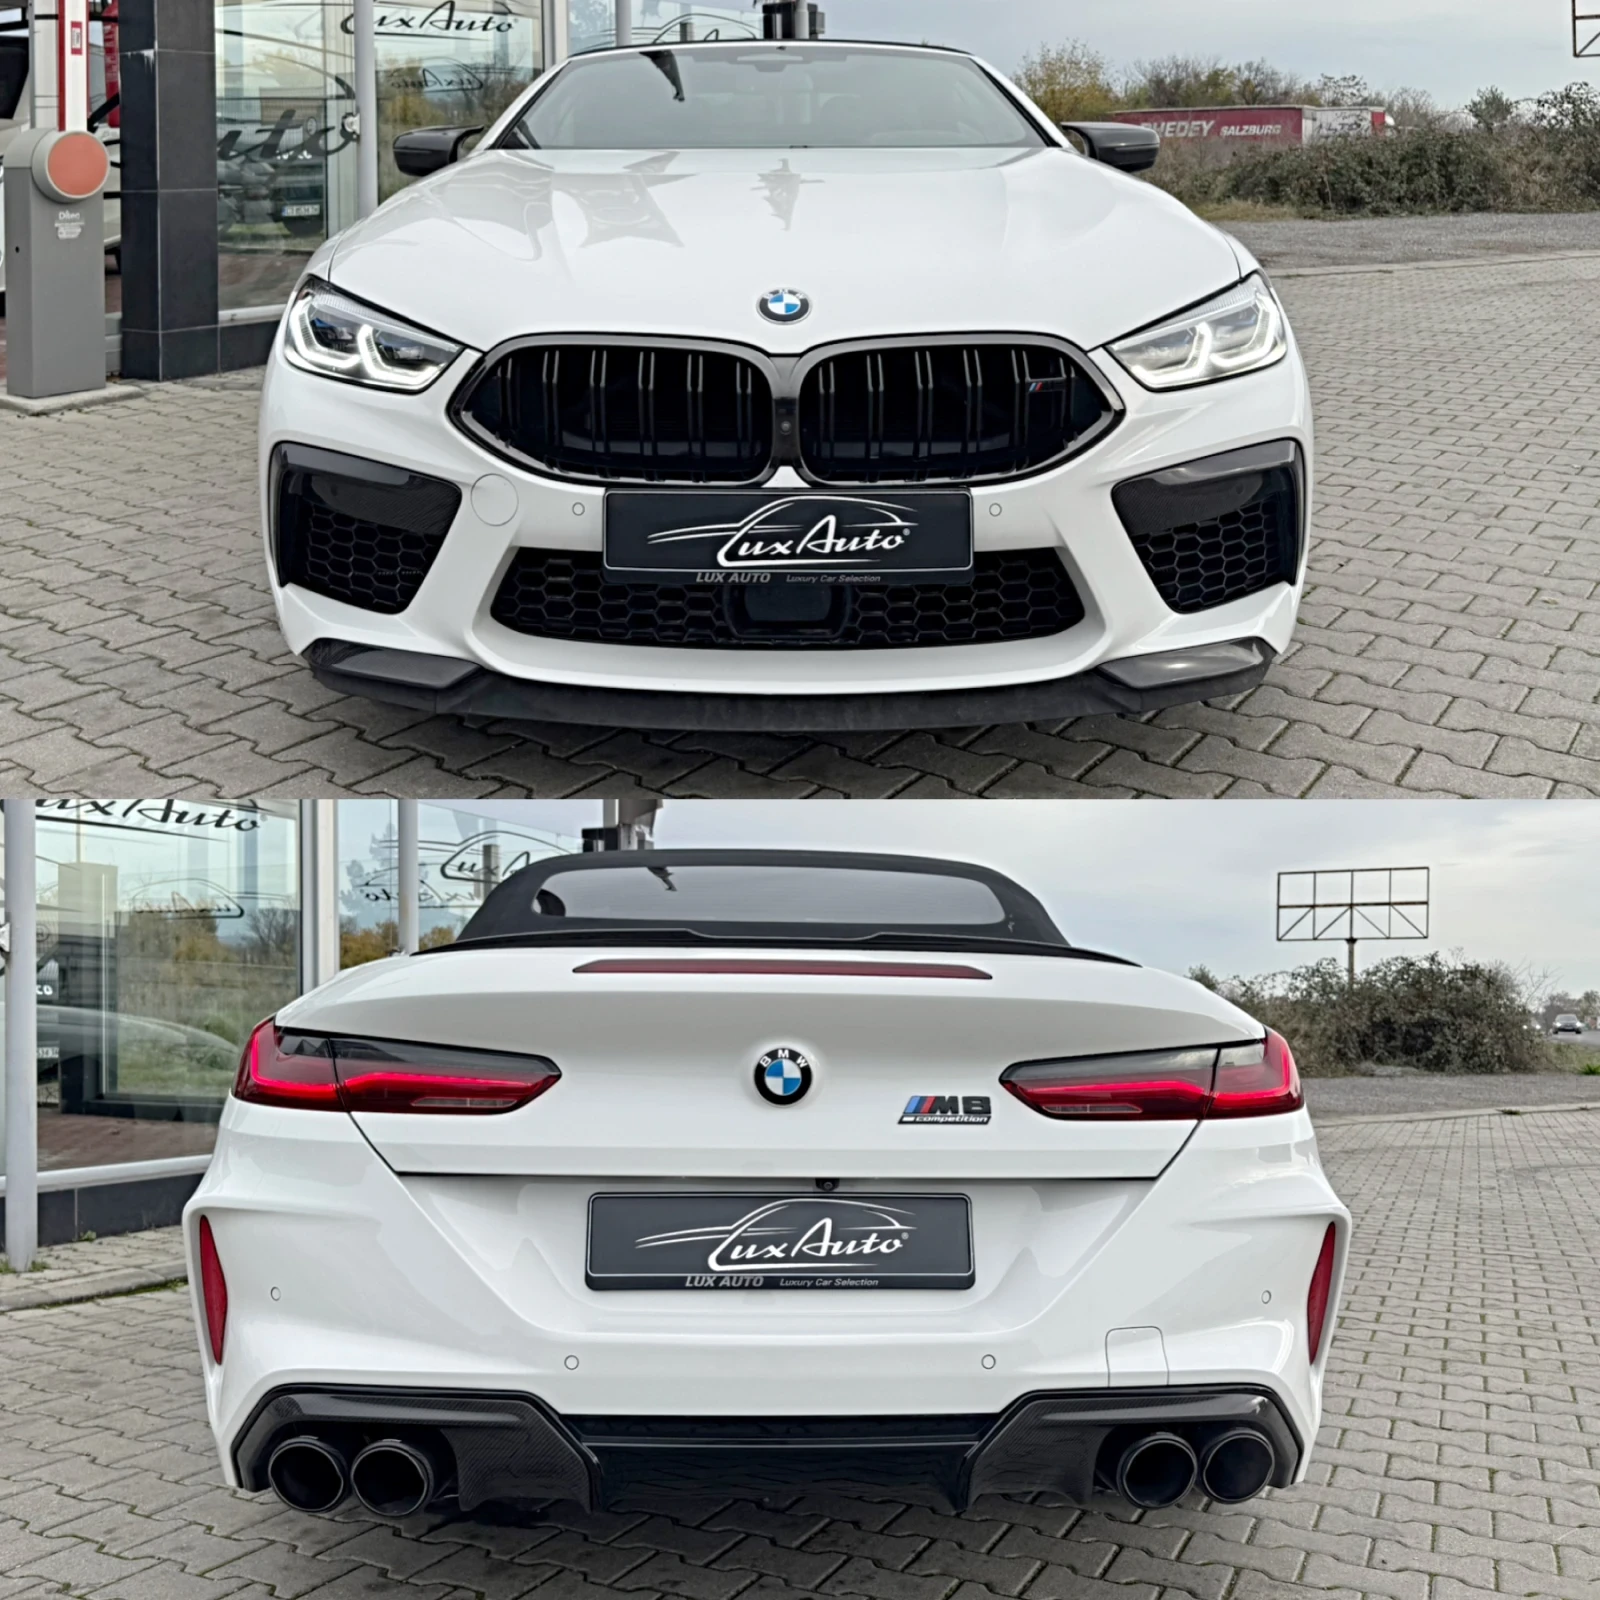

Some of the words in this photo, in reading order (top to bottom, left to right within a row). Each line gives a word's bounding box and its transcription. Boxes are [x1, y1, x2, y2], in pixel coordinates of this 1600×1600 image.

[1220, 124, 1281, 137] SALZBURG
[717, 510, 794, 568] Lux
[696, 572, 727, 584] LUX
[728, 572, 771, 584] AUTO
[786, 574, 817, 584] Luxury
[820, 575, 842, 583] Car
[844, 574, 881, 583] Selection
[915, 1115, 988, 1123] competition
[708, 1210, 788, 1271] Lux
[685, 1275, 717, 1288] LUX
[718, 1275, 764, 1288] AUTO
[779, 1278, 813, 1287] Luxury
[815, 1278, 833, 1287] Car
[834, 1277, 879, 1287] Selection
